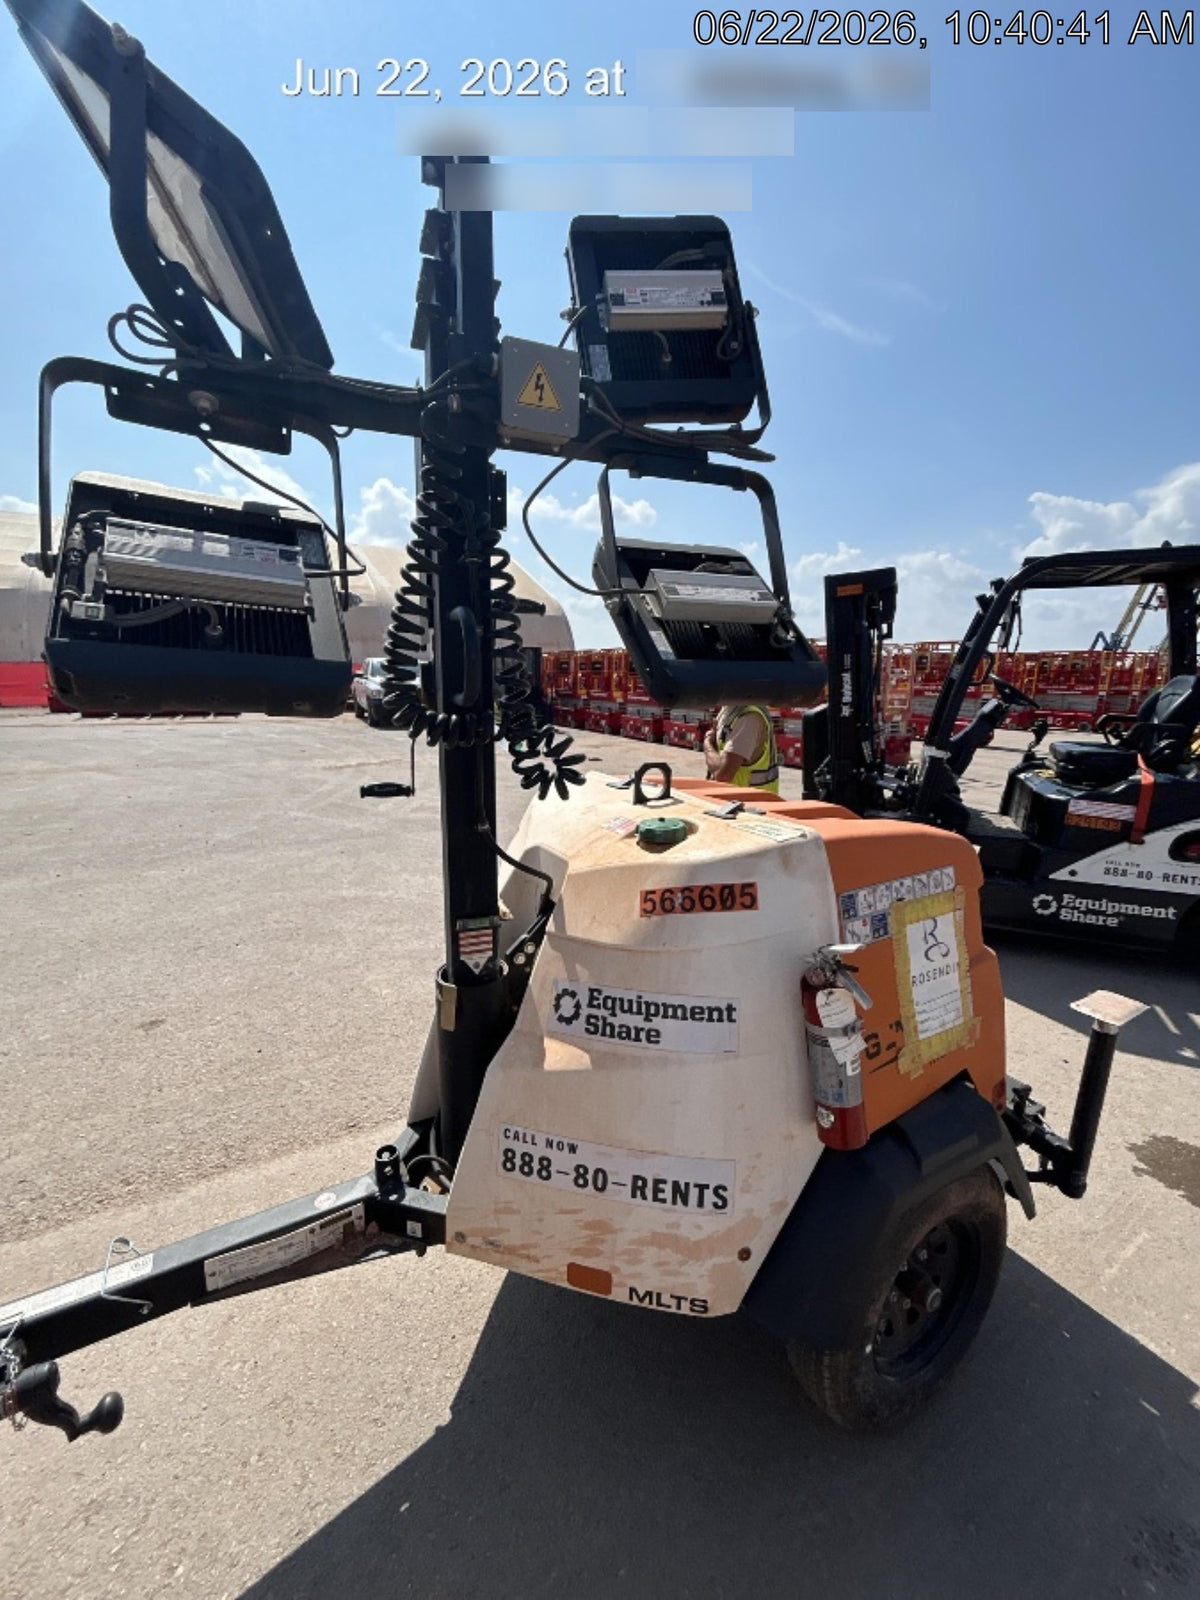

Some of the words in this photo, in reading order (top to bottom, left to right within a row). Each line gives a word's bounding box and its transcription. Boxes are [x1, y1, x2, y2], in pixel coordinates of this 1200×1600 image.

[642, 881, 757, 915] 566605
[1060, 893, 1178, 920] Equipment
[1059, 907, 1119, 928] Share
[586, 987, 737, 1024] Equipment
[584, 1015, 662, 1045] Share
[503, 1127, 538, 1147] CALL
[545, 1137, 579, 1155] NOW
[501, 1147, 729, 1210] 888-80-RENTS
[628, 1286, 710, 1315] MLTS
